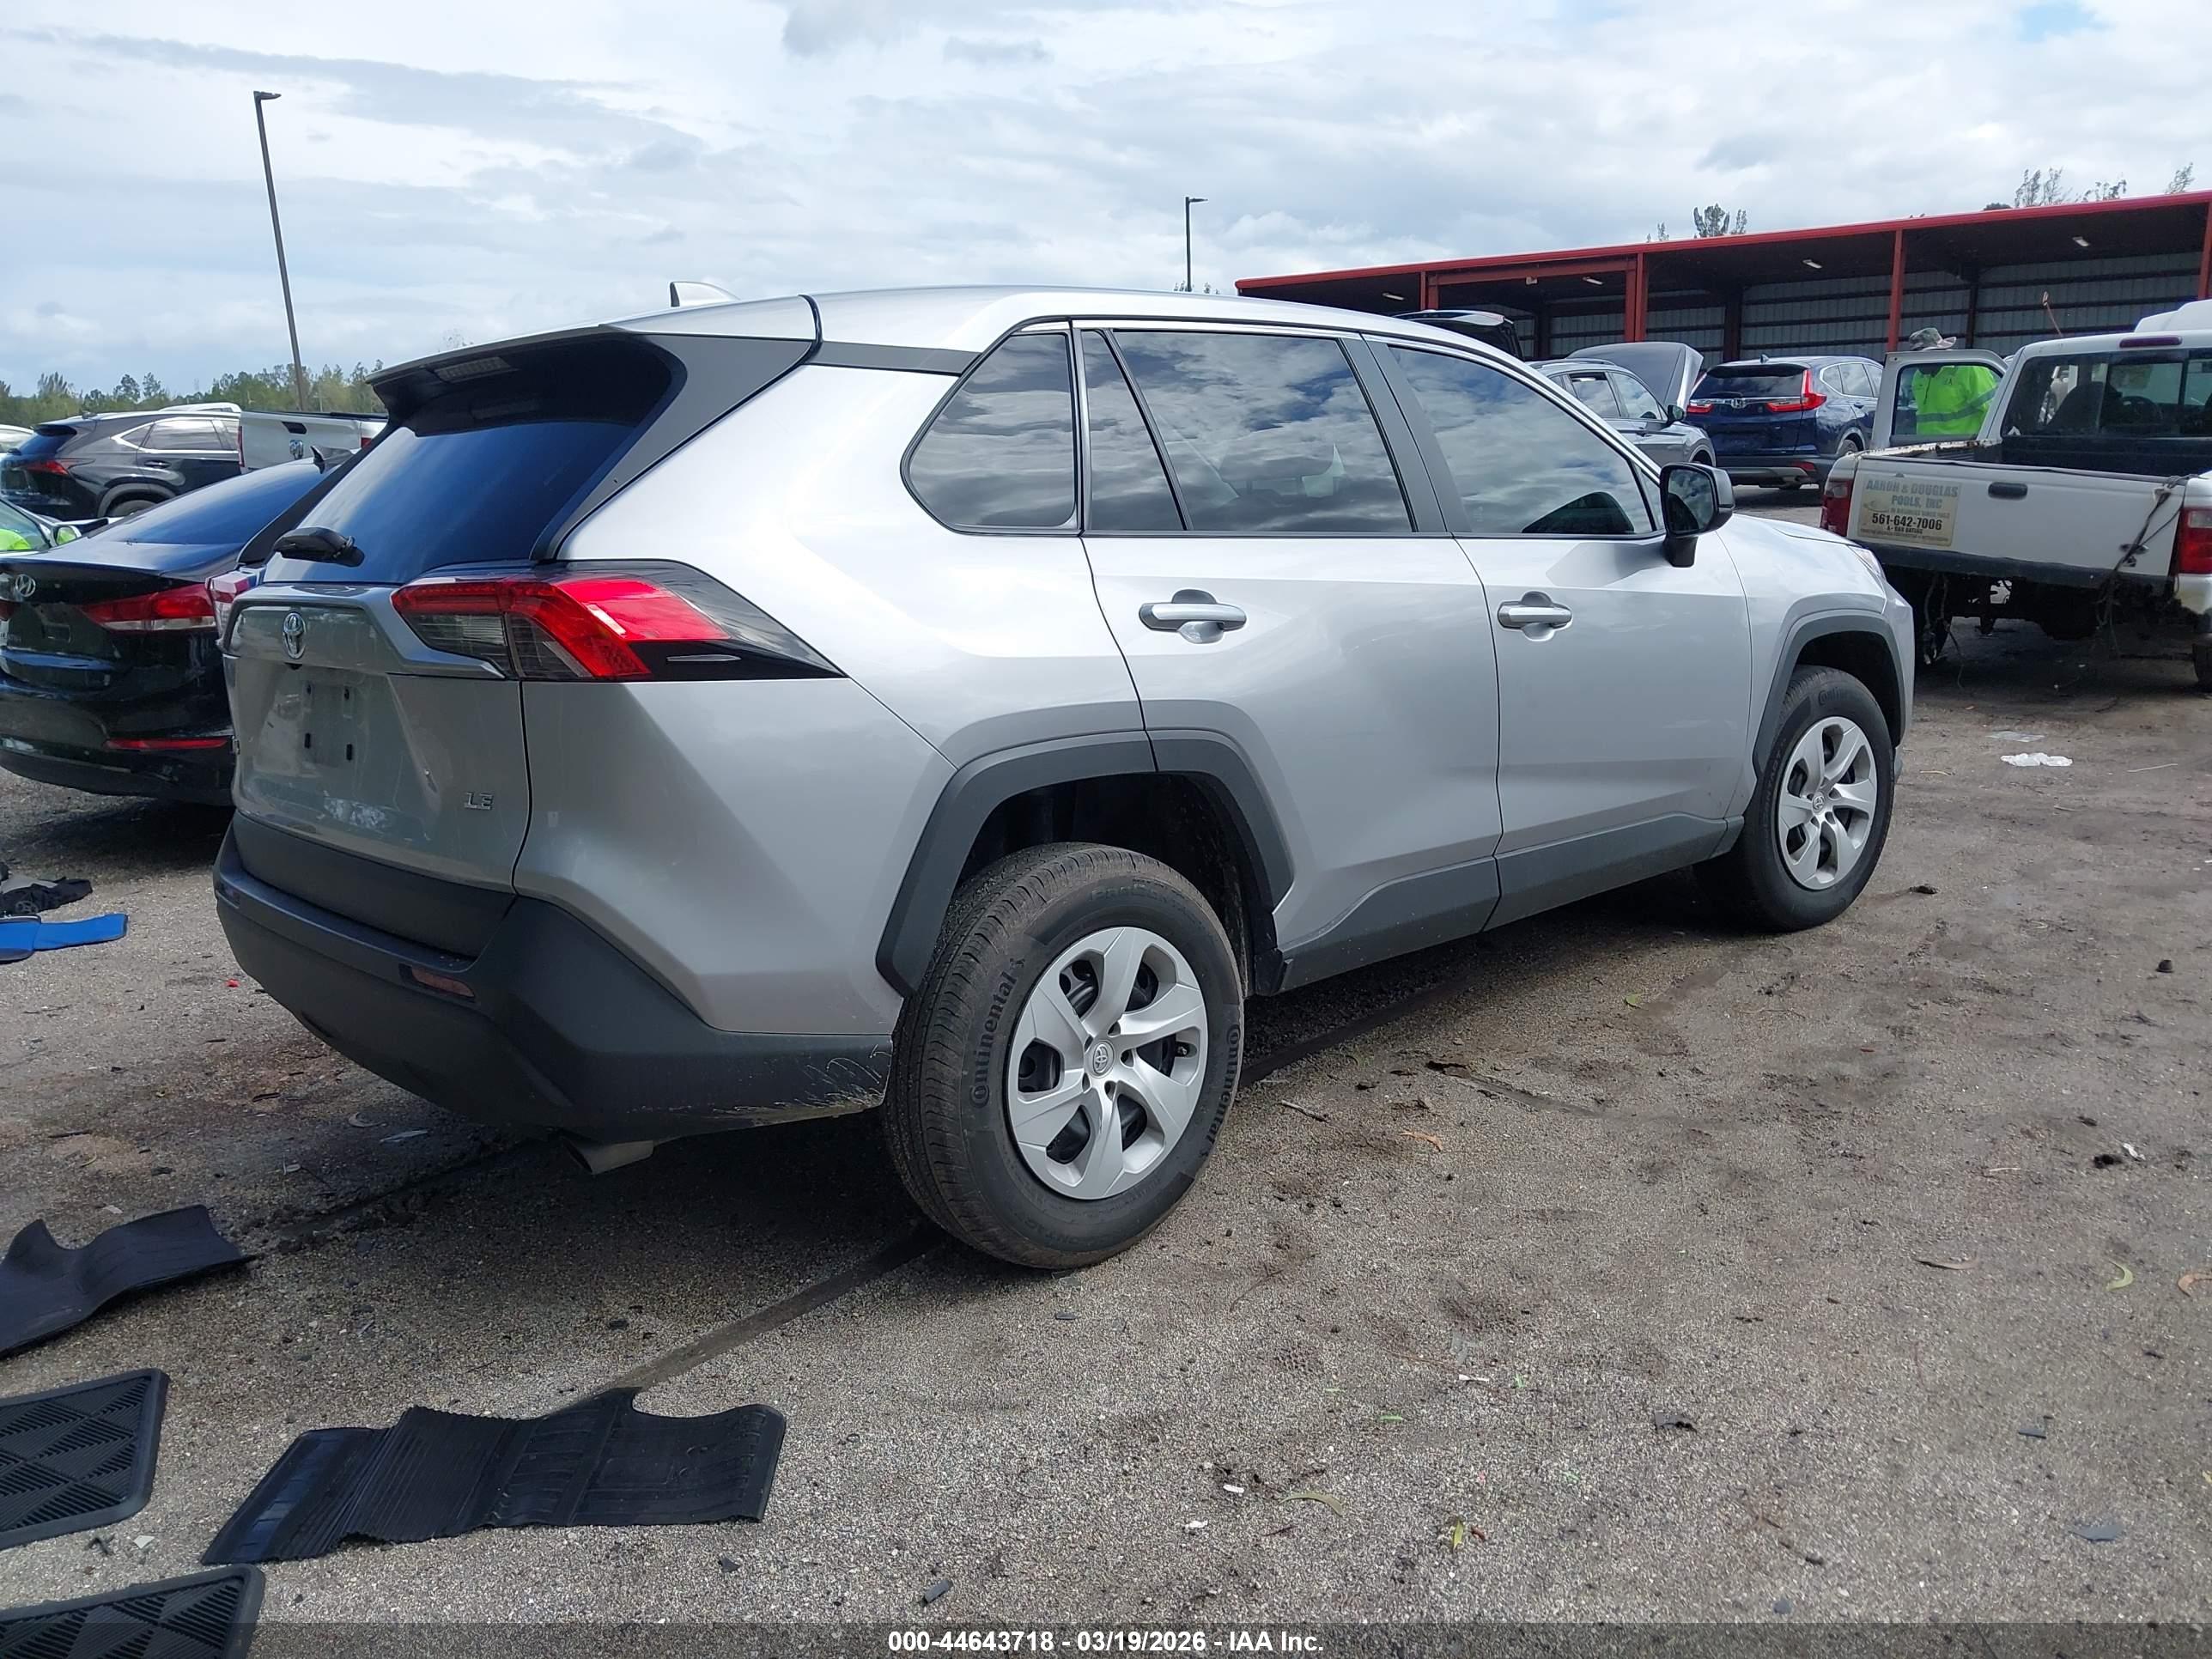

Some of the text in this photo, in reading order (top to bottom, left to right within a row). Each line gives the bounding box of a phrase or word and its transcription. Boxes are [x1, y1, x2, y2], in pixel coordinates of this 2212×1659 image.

[1911, 483, 1958, 497] DOUGLAS
[1872, 513, 1942, 531] 561-642-7006
[465, 792, 493, 811] LE
[969, 971, 1018, 1108] Continental
